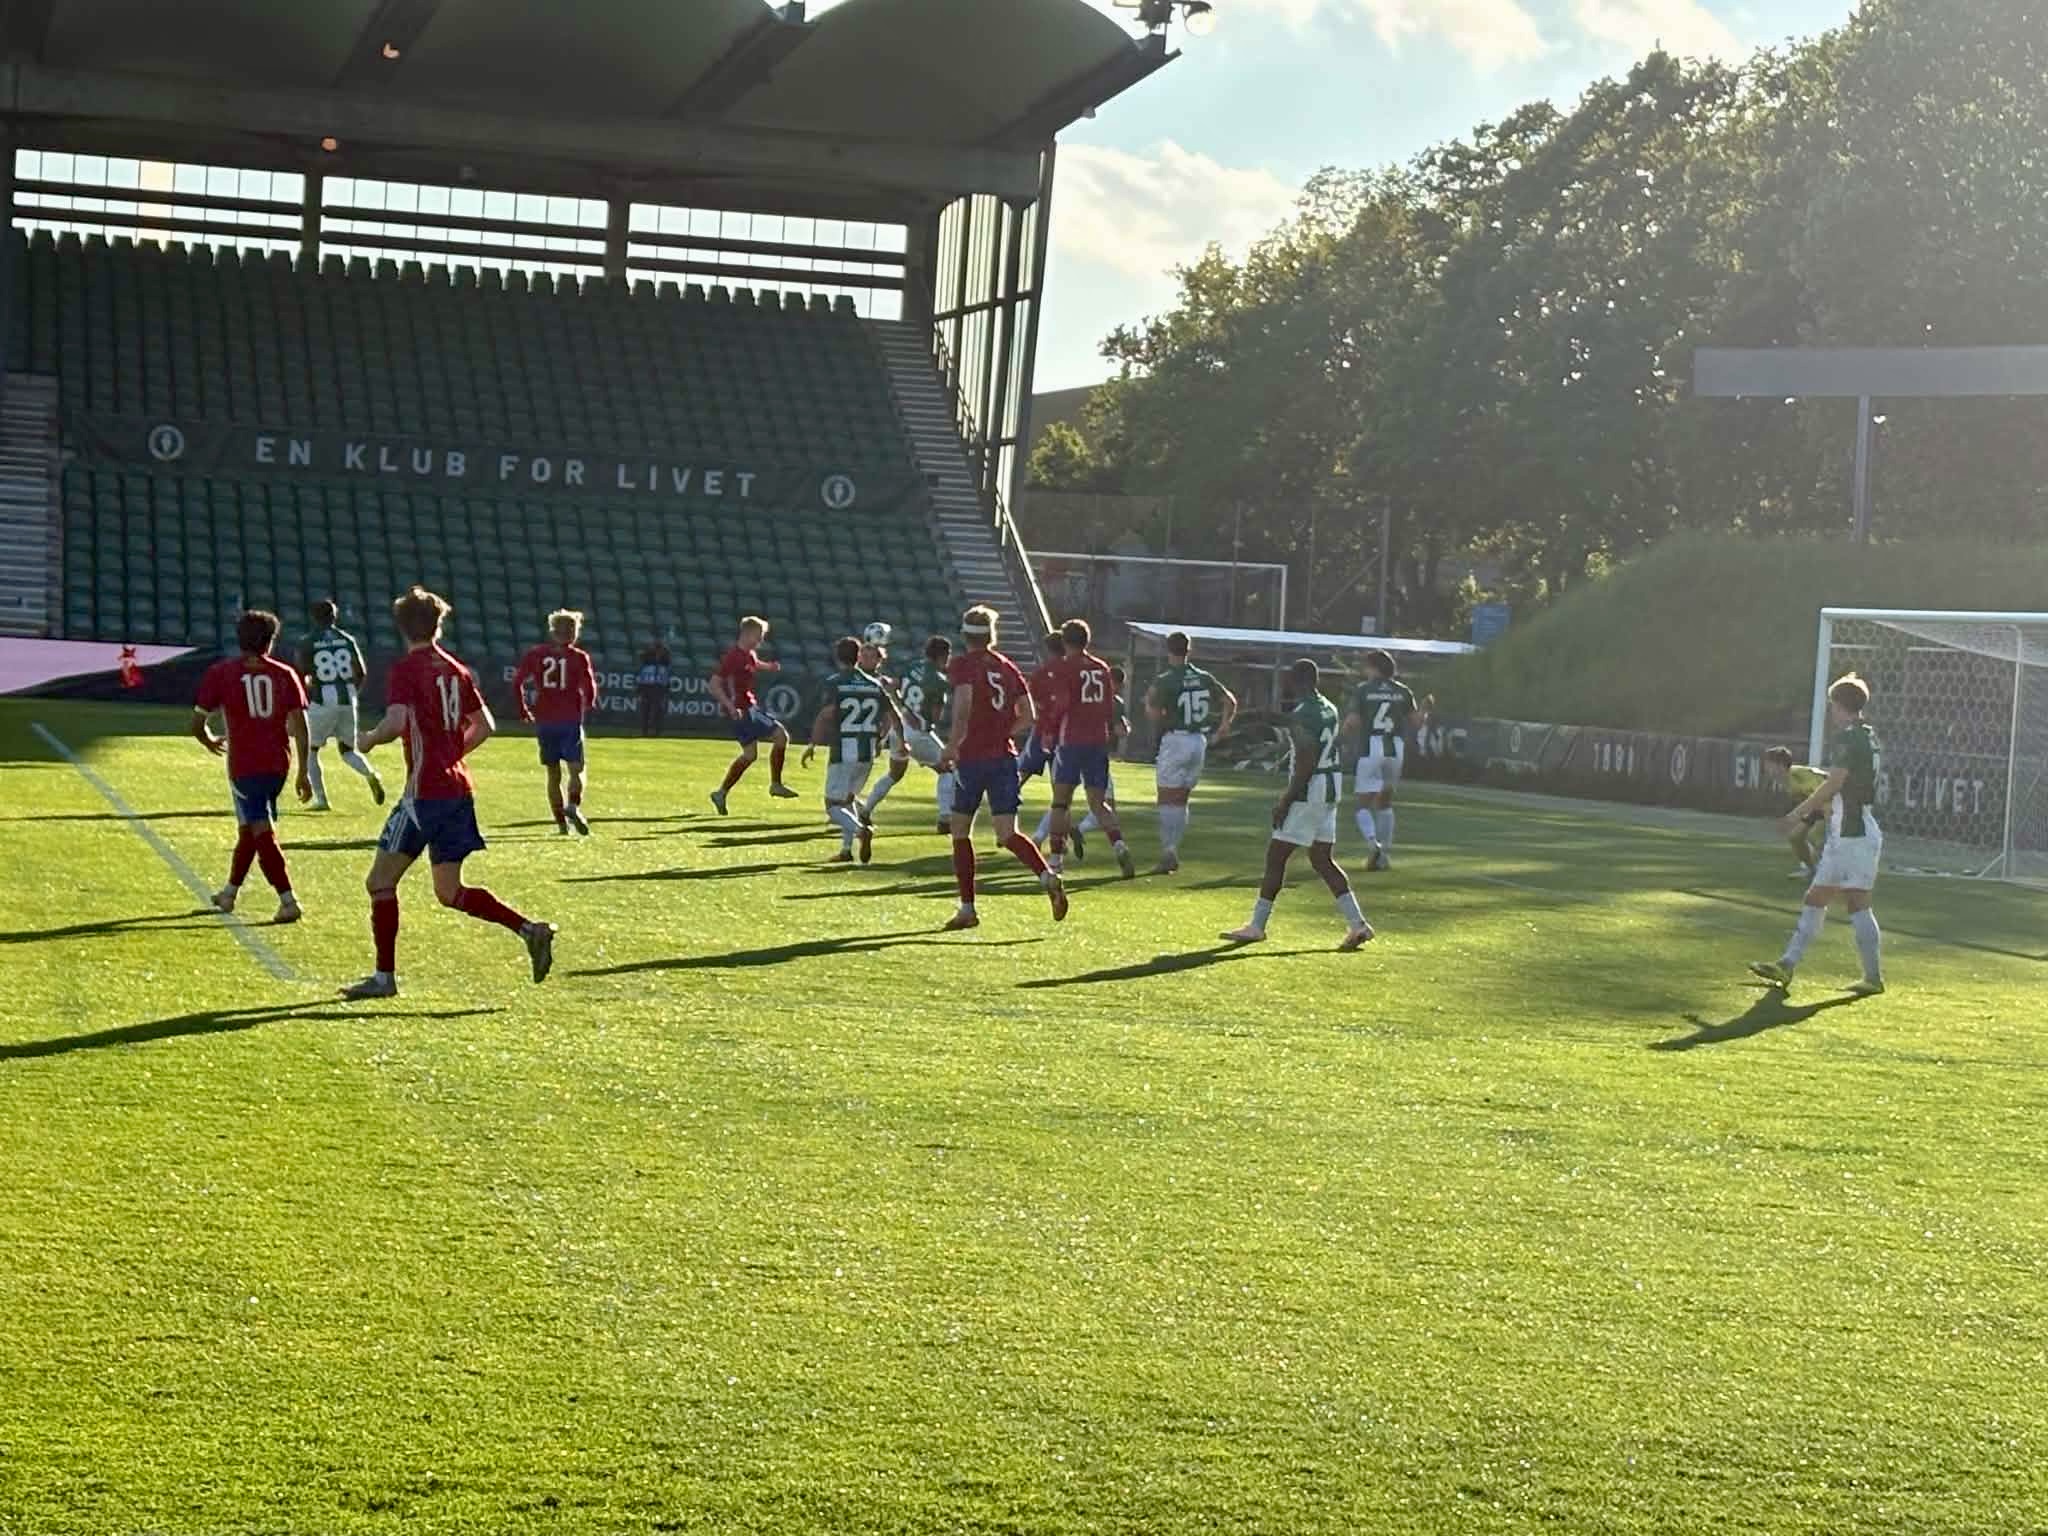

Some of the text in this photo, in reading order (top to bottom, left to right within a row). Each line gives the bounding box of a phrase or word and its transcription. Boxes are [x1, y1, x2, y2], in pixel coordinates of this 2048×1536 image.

[257, 437, 757, 497] EN KLUB FOR LIVET
[314, 648, 352, 681] 88
[542, 656, 567, 690] 21
[241, 673, 273, 718] 10
[436, 674, 460, 731] 14
[987, 671, 1004, 711] 5
[1079, 669, 1104, 703] 25
[839, 697, 880, 732] 22
[1177, 689, 1210, 725] 15
[1373, 701, 1394, 733] 4
[1735, 756, 1760, 790] EN
[1905, 774, 1985, 814] LIVET
